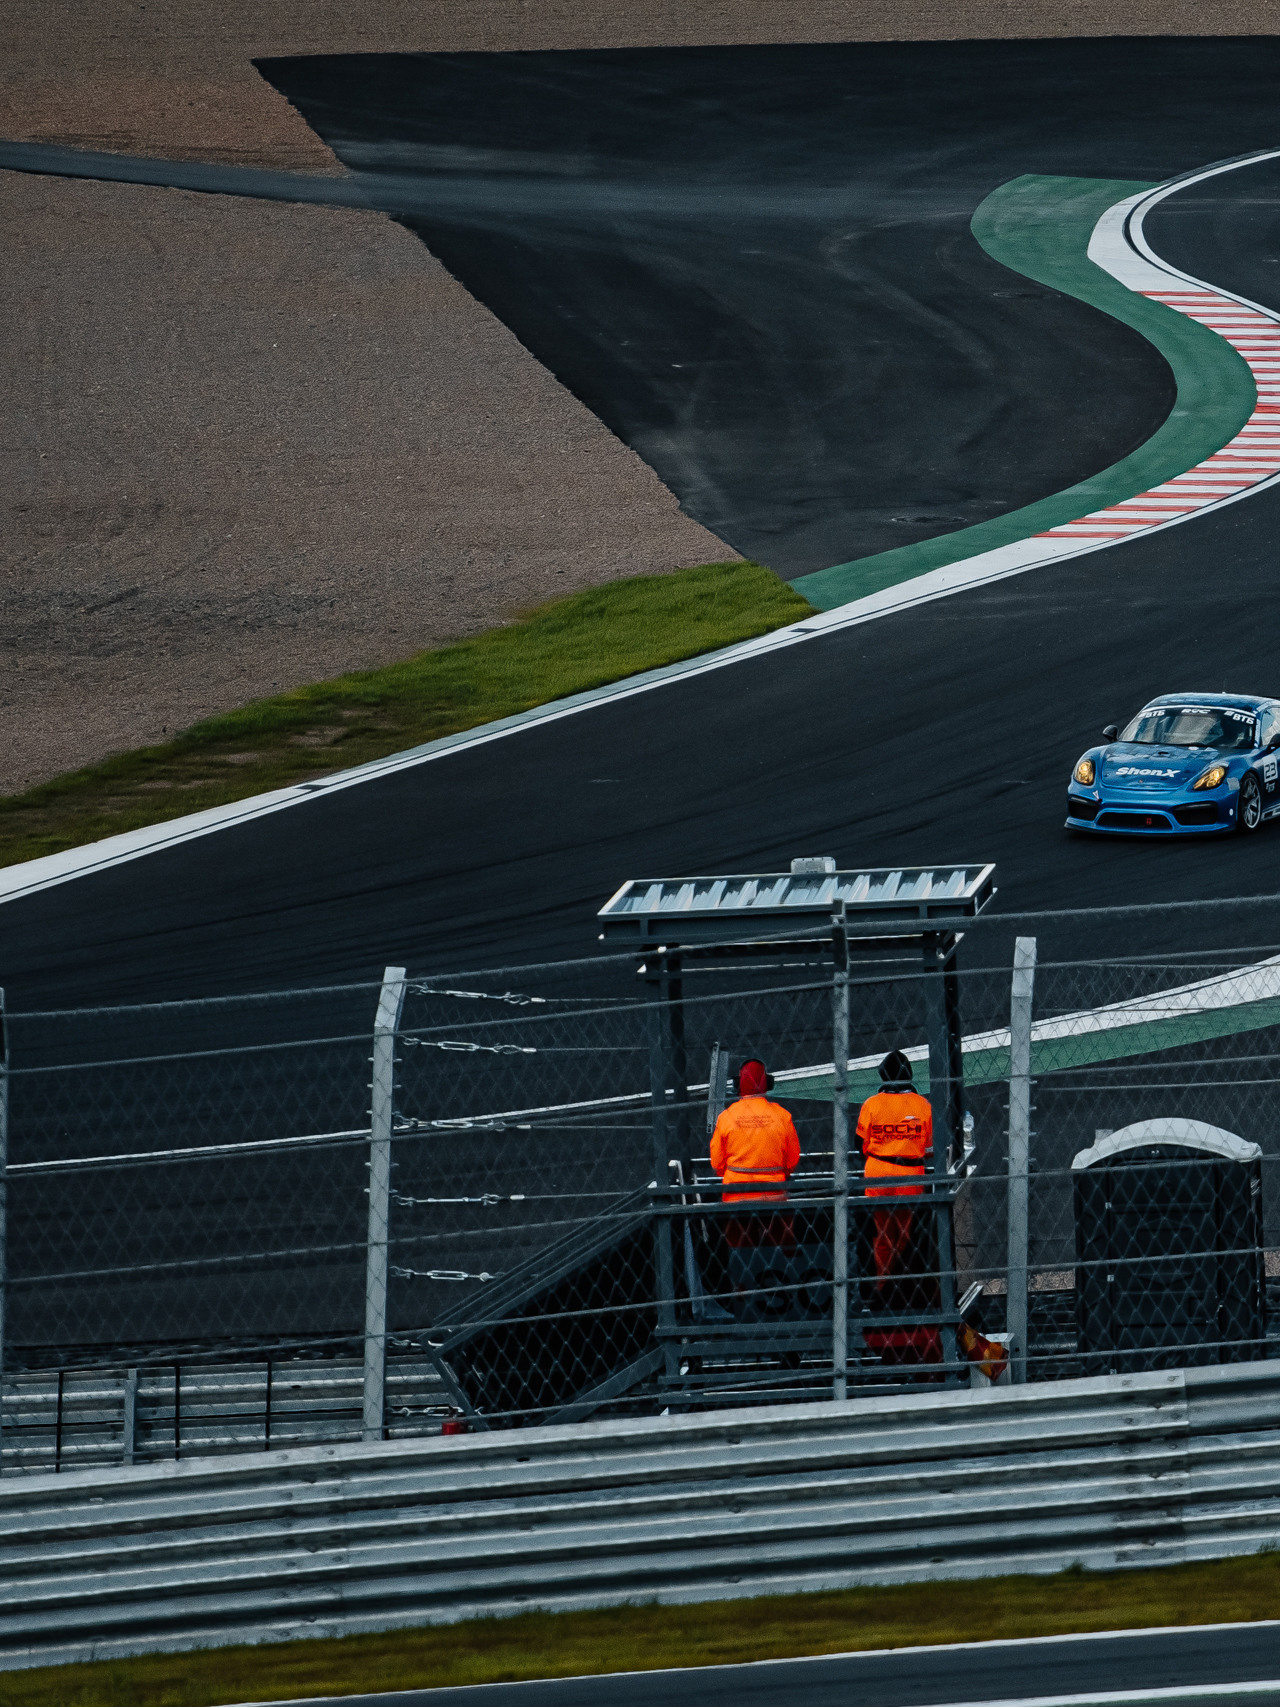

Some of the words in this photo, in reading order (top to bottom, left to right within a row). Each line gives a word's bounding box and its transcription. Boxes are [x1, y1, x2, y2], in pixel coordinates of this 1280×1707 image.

[1115, 766, 1181, 778] ShonX
[1264, 761, 1277, 780] 23
[871, 1124, 922, 1134] SOCHI
